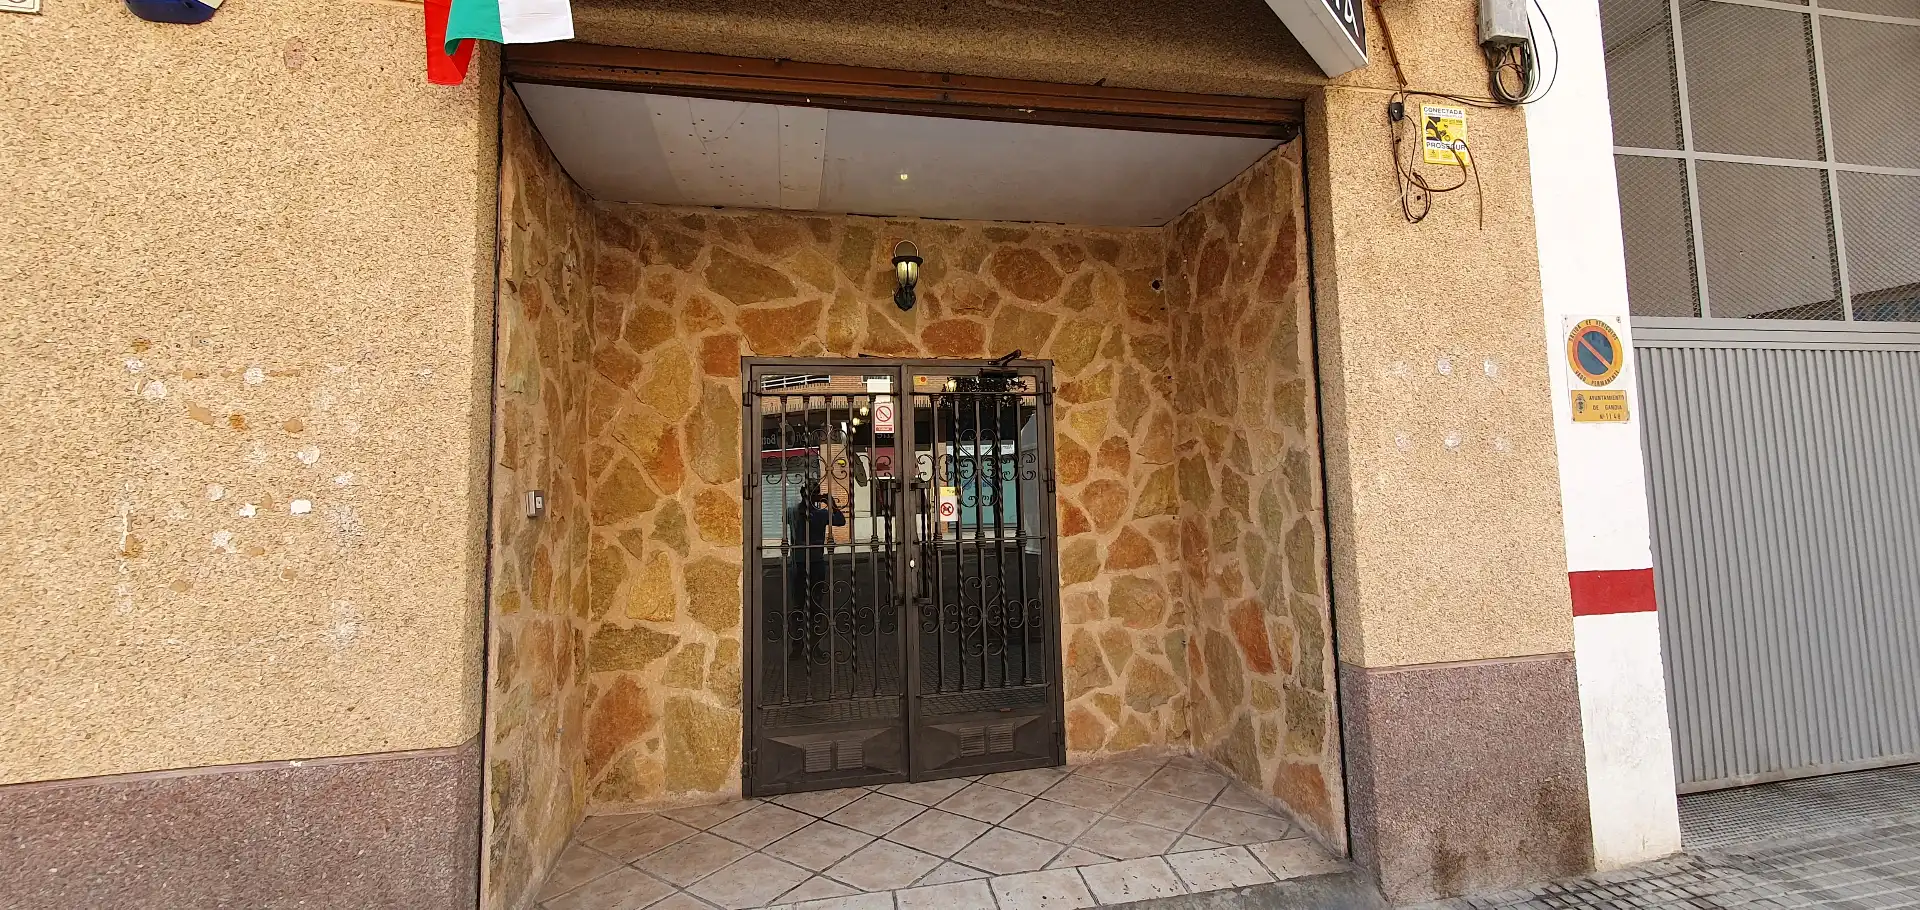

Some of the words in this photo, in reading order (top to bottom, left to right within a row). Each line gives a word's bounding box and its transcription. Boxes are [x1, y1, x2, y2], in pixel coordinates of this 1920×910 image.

[1424, 107, 1462, 115] CONECTADA
[1575, 369, 1587, 383] VADO
[1592, 369, 1620, 387] PERMANENTE
